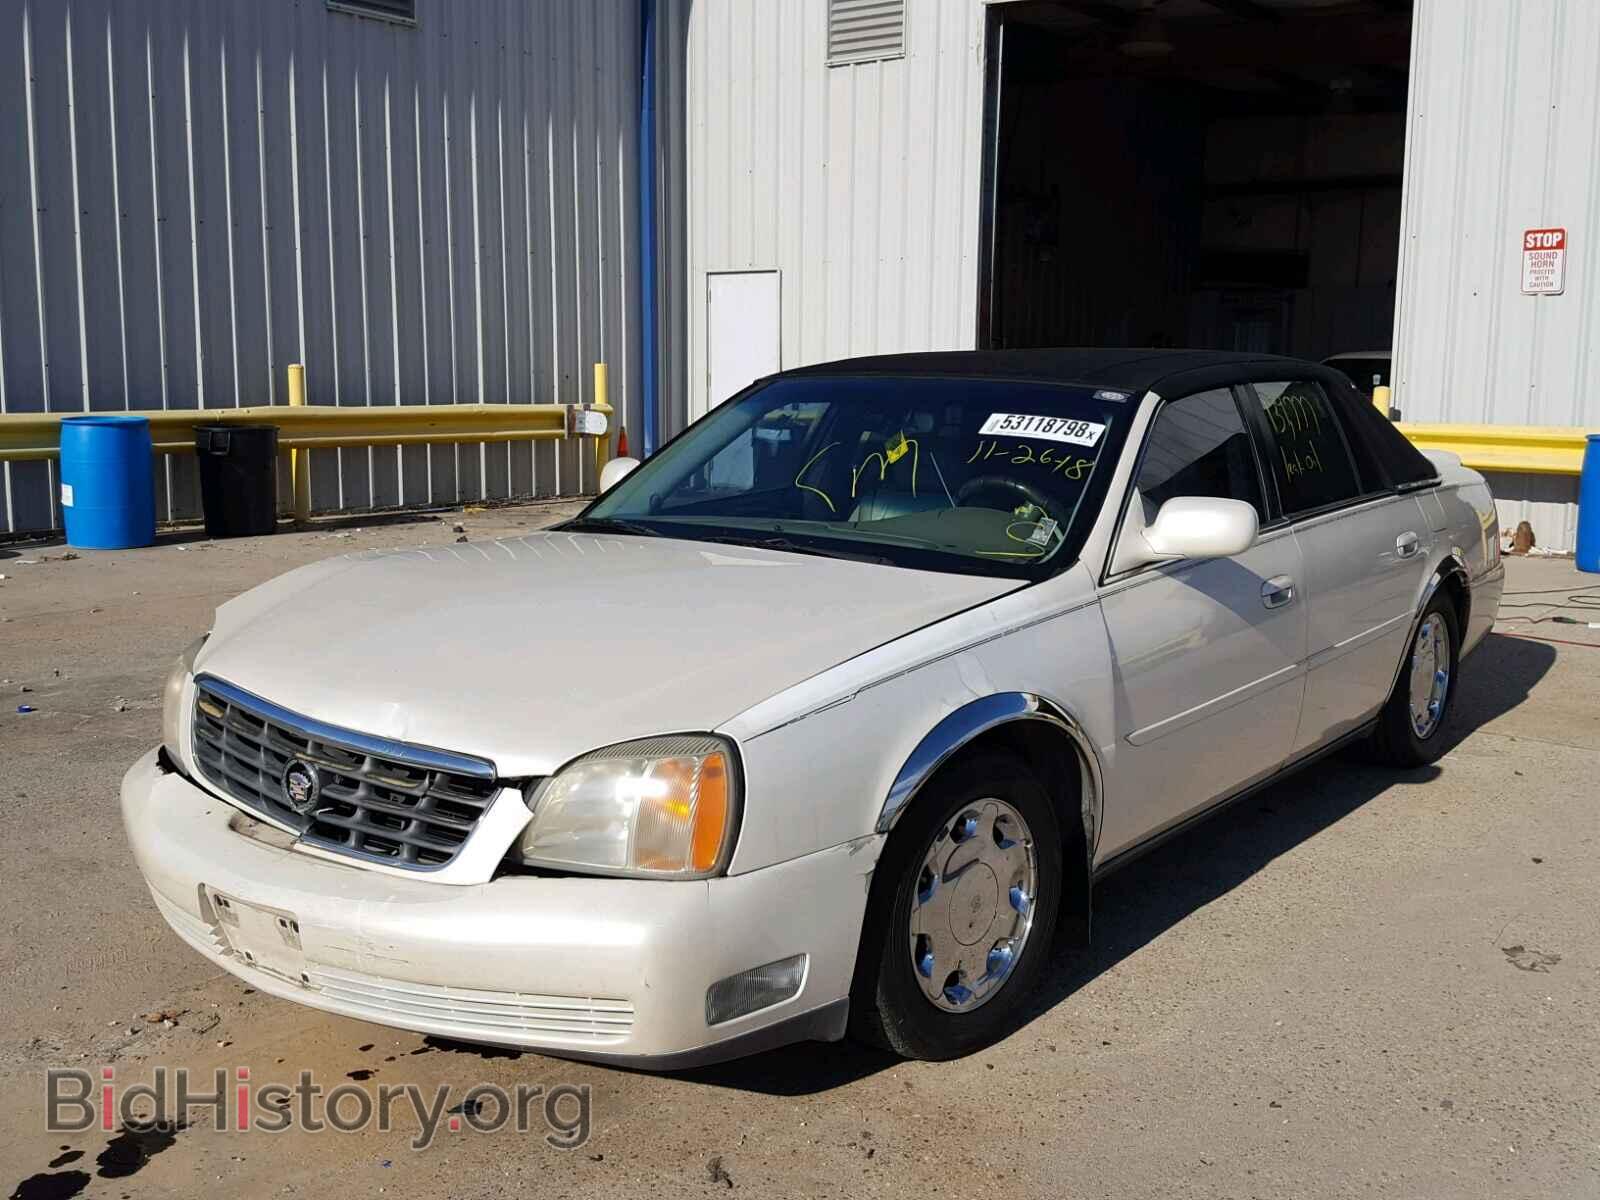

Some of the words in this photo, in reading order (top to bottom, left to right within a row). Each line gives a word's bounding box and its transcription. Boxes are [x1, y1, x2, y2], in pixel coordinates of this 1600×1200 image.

[1526, 232, 1562, 248] STOP
[1529, 252, 1557, 260] SOUND
[1531, 260, 1554, 268] HORN
